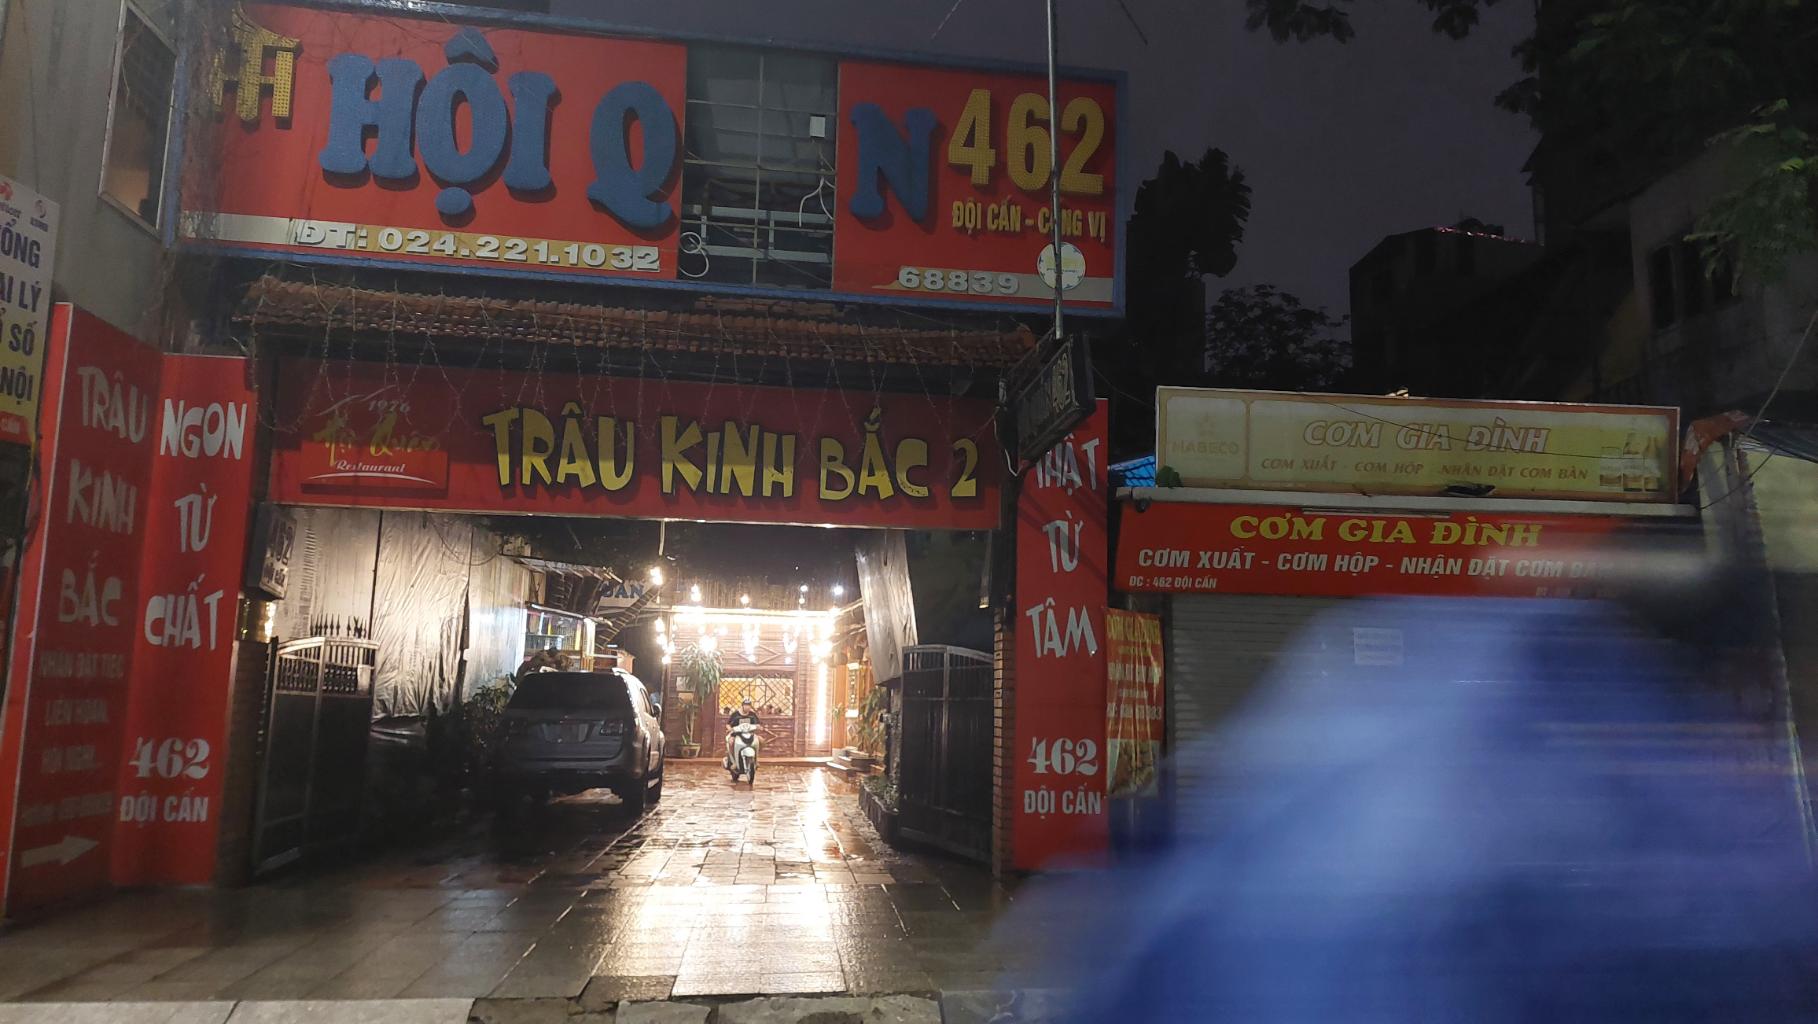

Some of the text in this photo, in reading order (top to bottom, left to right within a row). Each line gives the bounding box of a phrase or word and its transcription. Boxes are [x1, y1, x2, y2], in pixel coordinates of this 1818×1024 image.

[319, 26, 561, 215] HỘI
[949, 88, 1104, 194] 462
[952, 197, 982, 235] ĐỘI
[987, 194, 1021, 233] CẤN
[1038, 206, 1082, 237] CNG
[1088, 212, 1106, 243] VỊ
[0, 217, 40, 269] ỔNG
[377, 227, 661, 272] 024.221.1032
[18, 280, 42, 313] LÝ
[898, 267, 1019, 295] 68839
[8, 321, 38, 356] SỐ
[0, 365, 34, 406] NỘI
[77, 366, 148, 443] TRÂU
[160, 399, 247, 460] NGON
[483, 404, 977, 501] TRÂU KINH BẮC 2
[1396, 423, 1452, 450] GIA
[1464, 416, 1551, 453] ĐÌNH
[335, 459, 407, 473] Restaurant
[67, 457, 138, 535] KINH
[175, 483, 217, 552] TỪ
[1042, 509, 1083, 573] TỪ
[1230, 513, 1543, 547] CƠM GIA ĐÌNH
[1138, 548, 1190, 568] CƠM
[1197, 546, 1256, 570] XUẤT
[1277, 552, 1328, 572] CƠM
[1334, 552, 1380, 577] HỘP
[1400, 554, 1463, 579] NHẬN
[57, 550, 122, 627] BẮC
[144, 574, 224, 650] CHẤT
[1026, 597, 1098, 658] TÂM
[129, 736, 210, 780] 462
[1028, 737, 1098, 776] 462
[119, 790, 157, 828] ĐỘI
[163, 786, 208, 823] CẤN
[1024, 782, 1101, 820] ĐỘI CẤN
